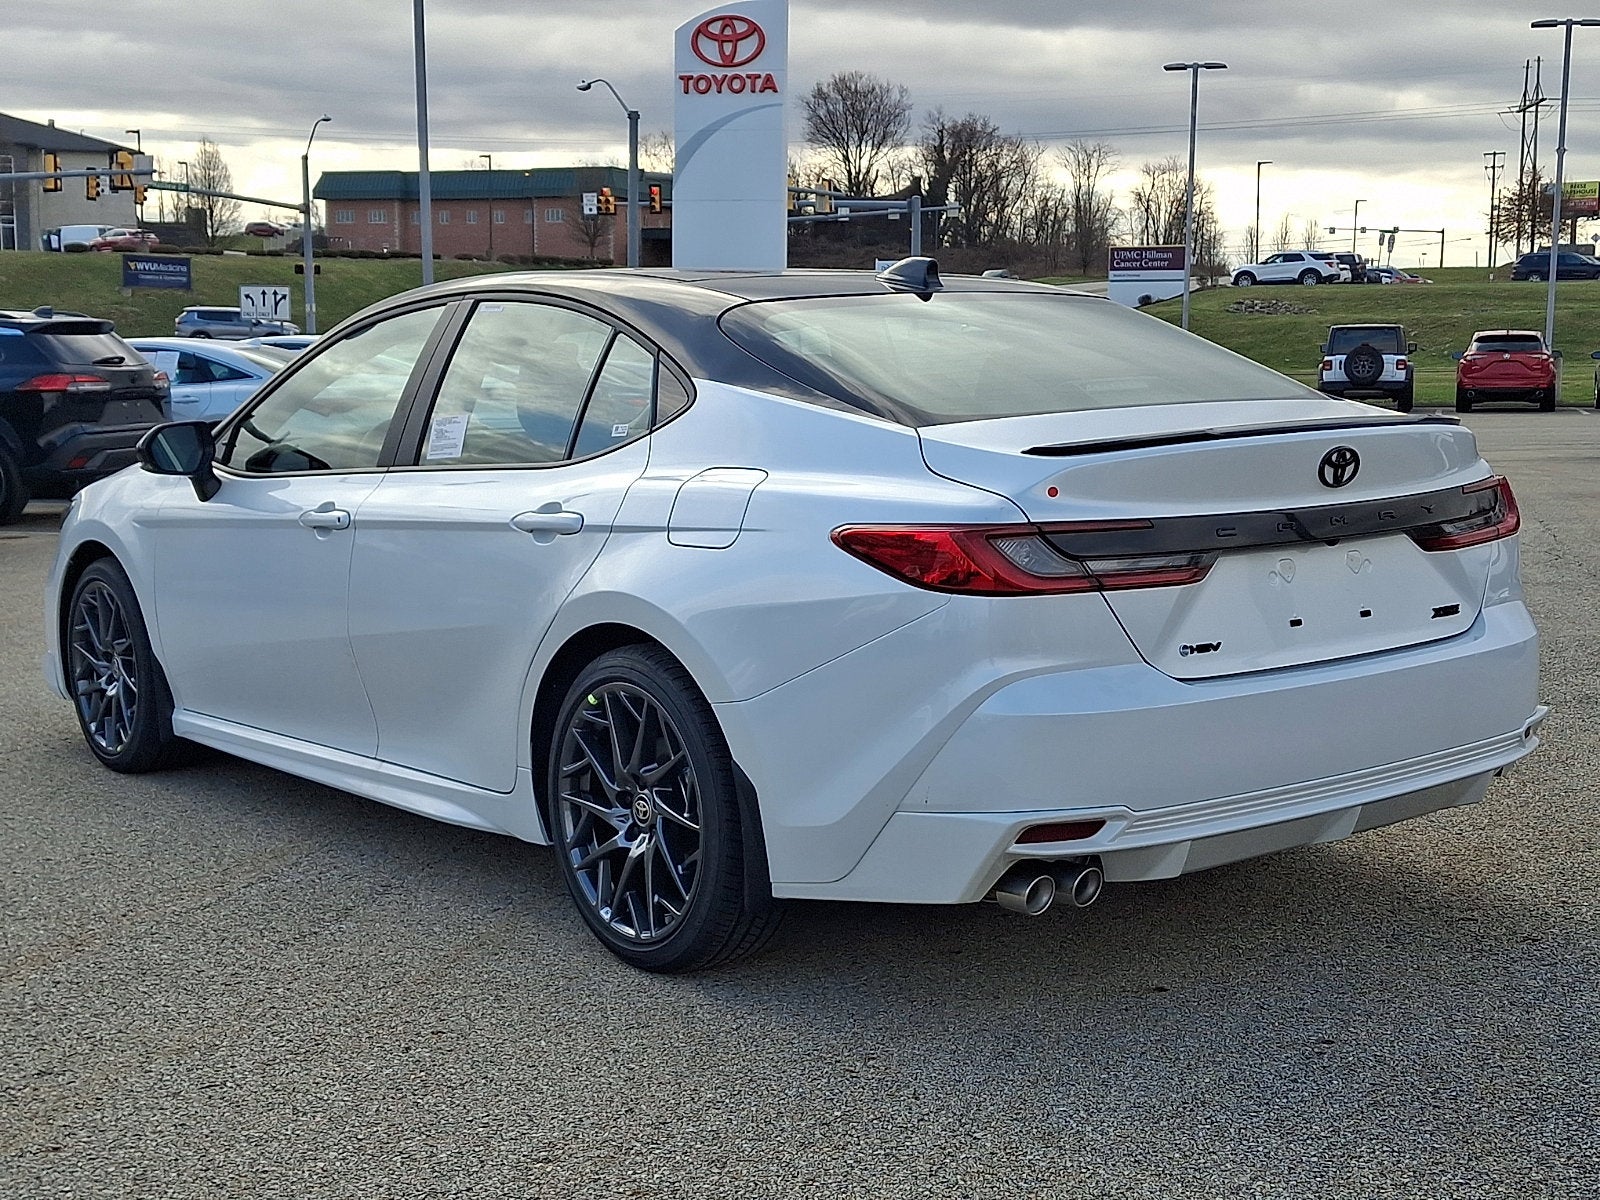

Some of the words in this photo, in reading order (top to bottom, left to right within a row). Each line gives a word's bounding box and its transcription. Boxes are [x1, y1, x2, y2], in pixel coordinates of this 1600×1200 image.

[679, 73, 778, 94] TOYOTA
[1114, 250, 1141, 259] UPMC
[1142, 250, 1172, 259] Hillman
[1113, 259, 1140, 267] Cancer
[1142, 259, 1169, 267] Center
